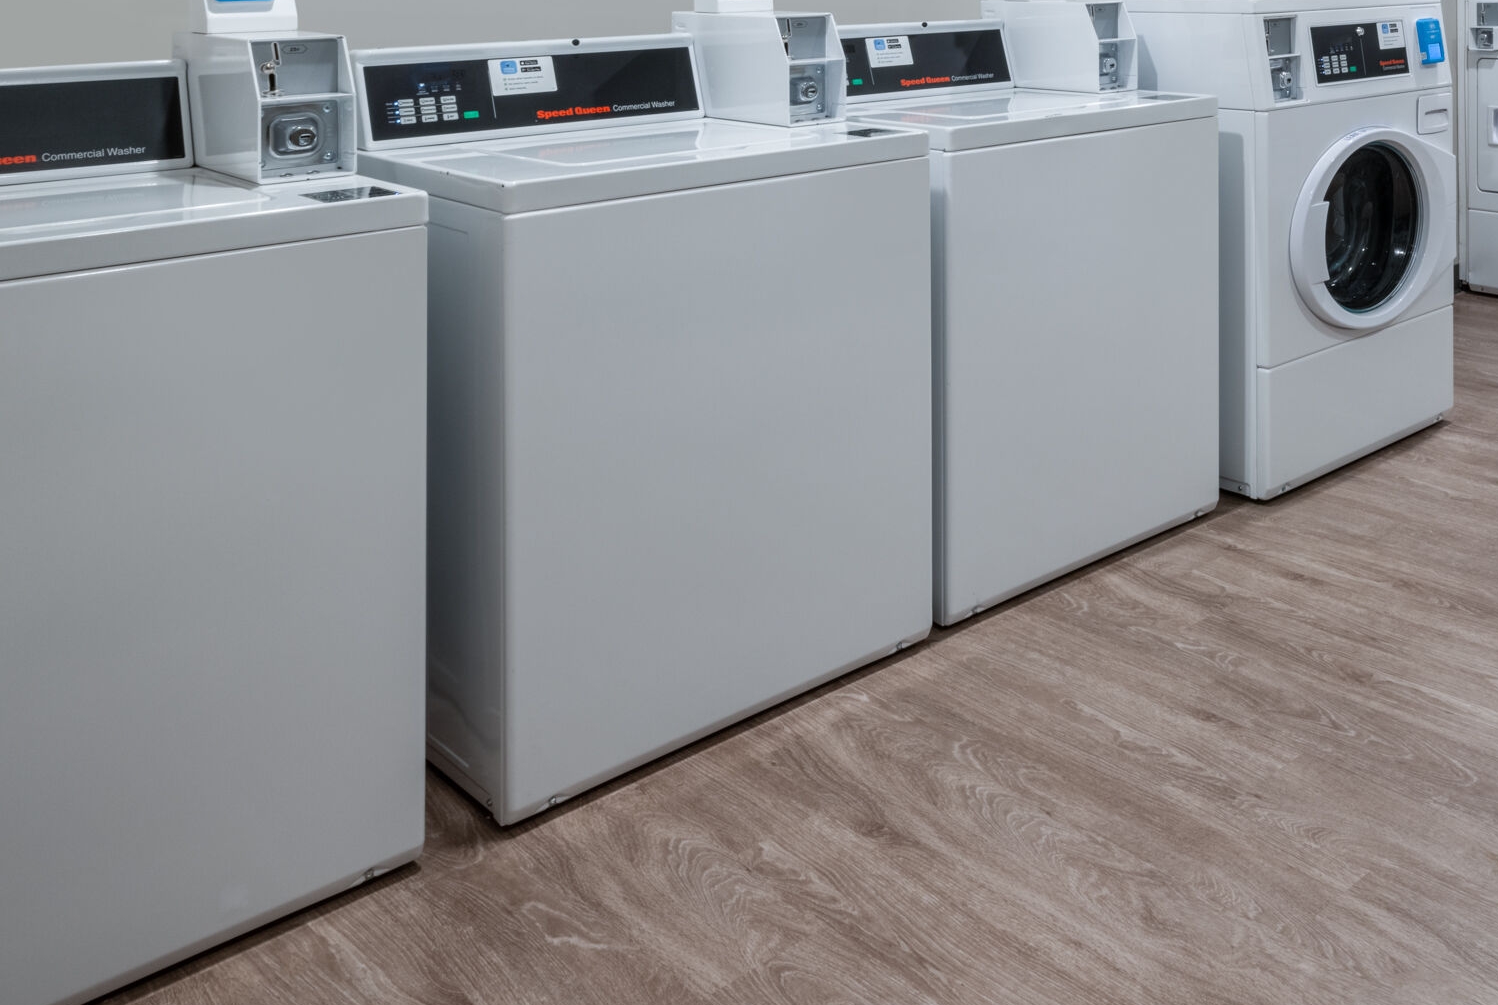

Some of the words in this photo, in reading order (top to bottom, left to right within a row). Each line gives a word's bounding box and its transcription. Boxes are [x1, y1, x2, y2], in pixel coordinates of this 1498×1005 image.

[900, 78, 925, 87] Speed
[926, 76, 950, 84] Queen
[536, 107, 573, 119] Speed
[575, 105, 611, 115] Queen
[613, 102, 650, 112] Commercial
[652, 100, 675, 108] Washer
[0, 155, 37, 165] een
[42, 149, 104, 162] Commercial
[107, 147, 146, 156] Washer
